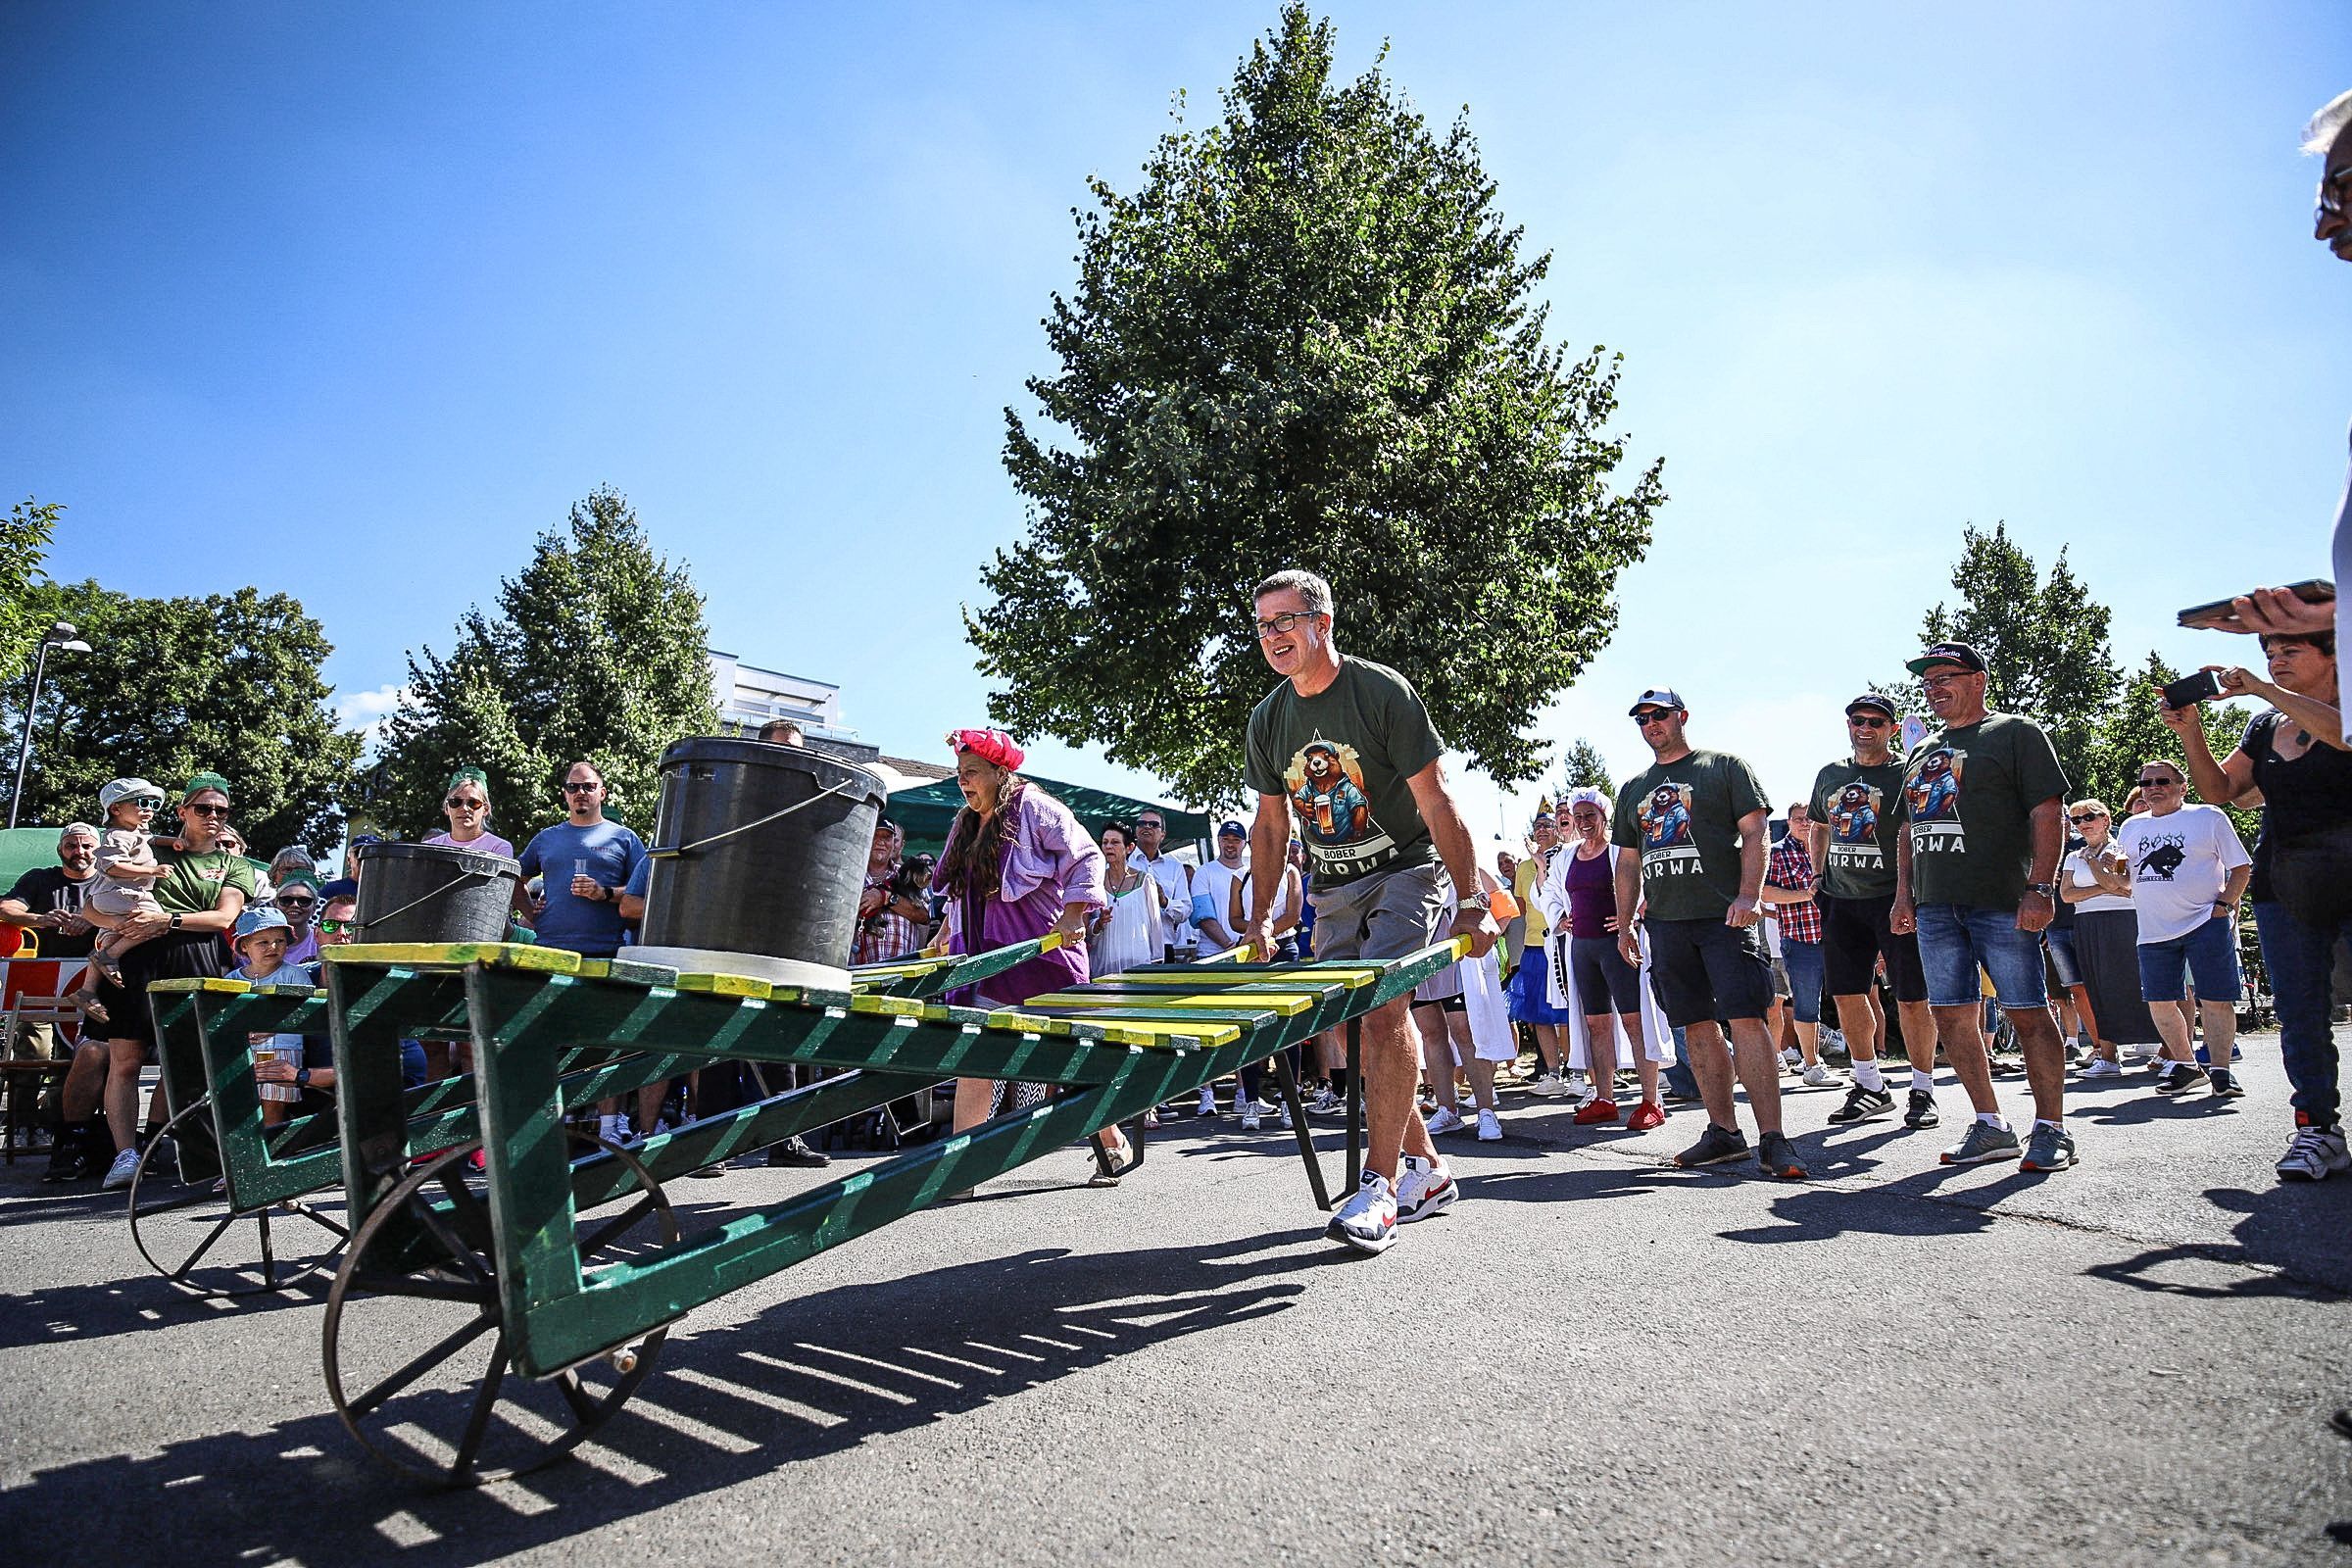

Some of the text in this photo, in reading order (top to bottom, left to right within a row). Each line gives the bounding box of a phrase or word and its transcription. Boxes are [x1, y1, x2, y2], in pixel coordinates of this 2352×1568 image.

[1913, 824, 1933, 835] BOBER
[1324, 849, 1356, 859] BOBER
[1649, 851, 1672, 861] BOBER
